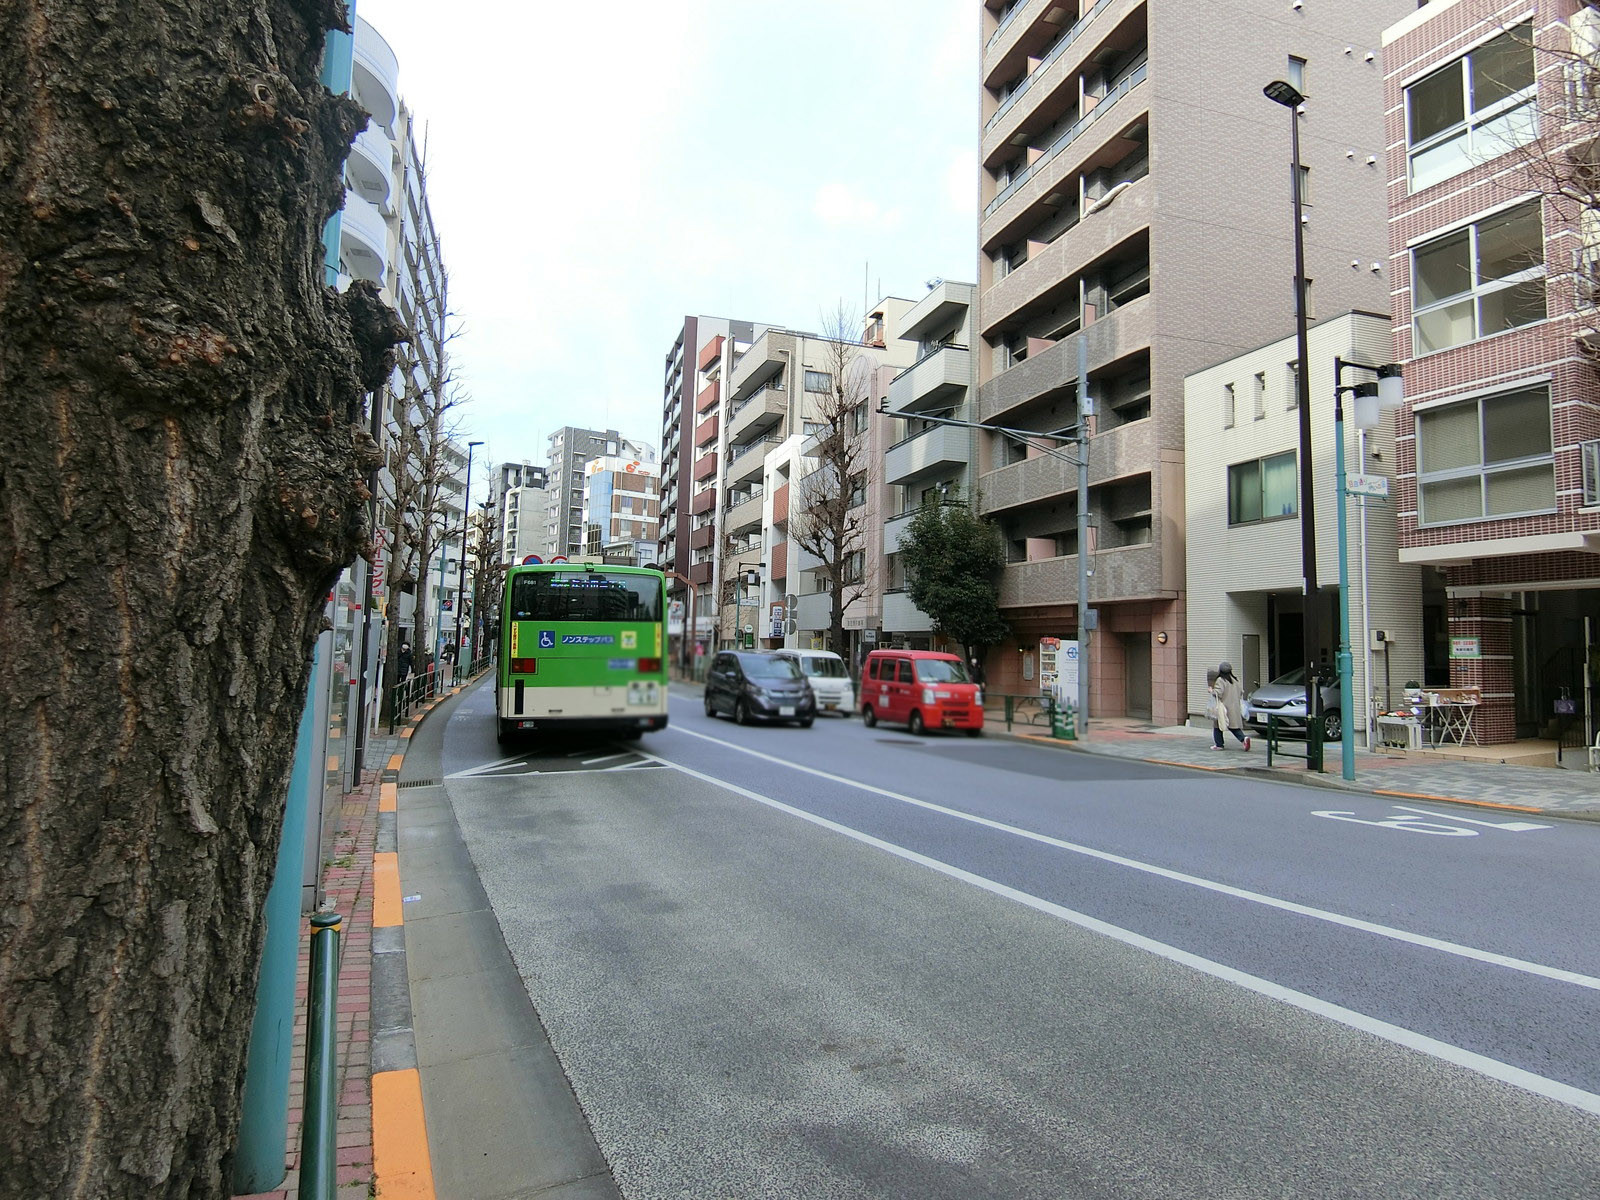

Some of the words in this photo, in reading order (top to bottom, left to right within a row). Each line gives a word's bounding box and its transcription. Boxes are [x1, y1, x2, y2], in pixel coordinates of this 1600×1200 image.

[562, 636, 614, 644] ノンステップバス
